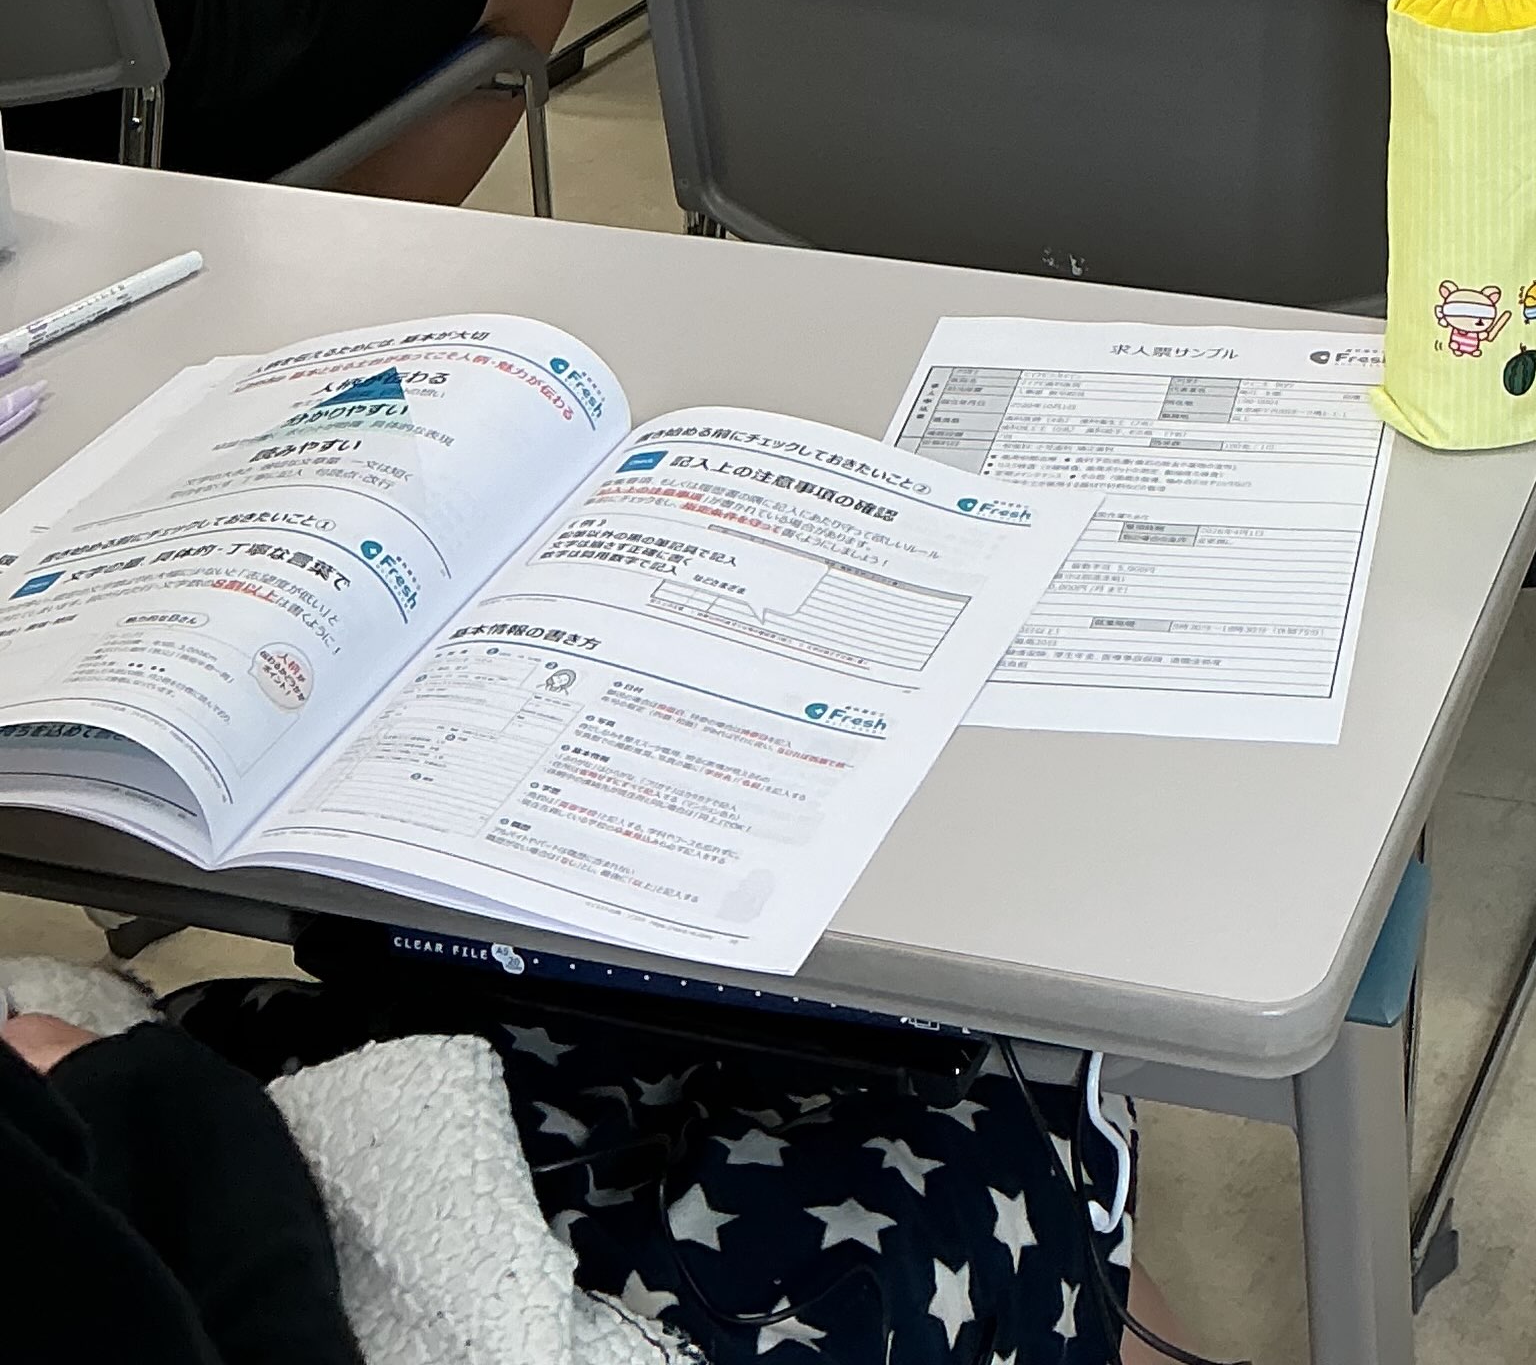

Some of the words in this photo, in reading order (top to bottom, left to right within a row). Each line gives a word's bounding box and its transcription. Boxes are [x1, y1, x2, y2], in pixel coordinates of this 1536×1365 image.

[1110, 344, 1240, 361] 求人票サンプル
[566, 369, 605, 419] Fresh
[670, 455, 899, 523] 記入上の注意事項の確認
[978, 501, 1031, 520] Fresh
[380, 554, 418, 610] Fresh
[449, 623, 602, 651] 基本情報の書き方
[828, 708, 887, 732] Fresh
[393, 936, 444, 954] CLEAR
[453, 945, 488, 961] FILE
